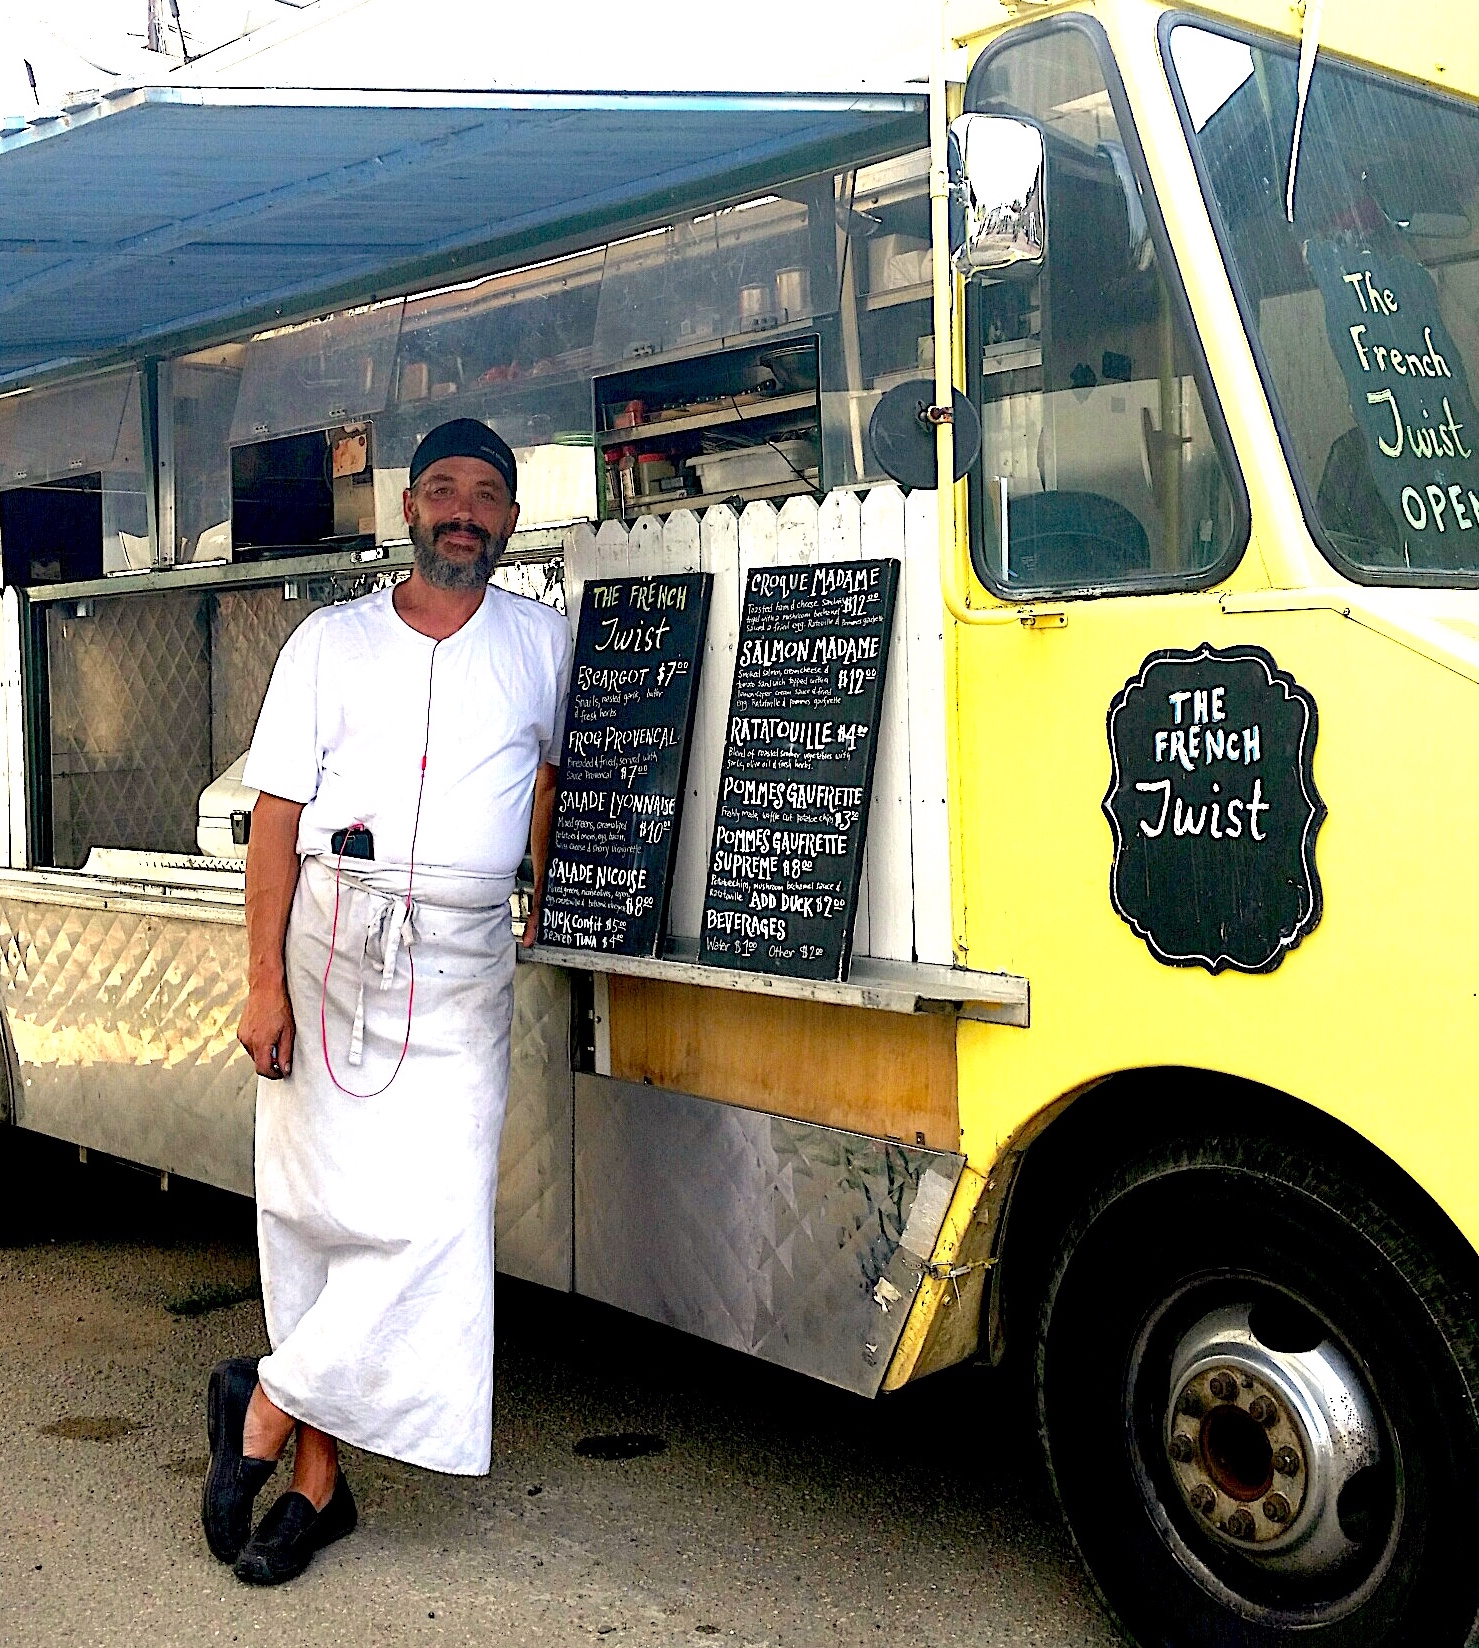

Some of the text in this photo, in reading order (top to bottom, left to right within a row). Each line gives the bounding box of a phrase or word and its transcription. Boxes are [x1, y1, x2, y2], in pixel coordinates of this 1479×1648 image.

[1343, 271, 1398, 316] The
[1350, 325, 1452, 377] French
[594, 583, 687, 611] THE FRENCH
[751, 568, 880, 599] CROQUE MADAME
[748, 604, 773, 614] Toasted
[740, 636, 879, 667] SALMON MADAME
[578, 666, 650, 692] ESCARGOT
[580, 709, 597, 722] fresh
[599, 708, 617, 717] herbs
[1168, 686, 1226, 725] THE
[569, 731, 602, 756] FROG
[730, 717, 833, 750] RATATOUILLE
[1155, 724, 1261, 771] FRENCH
[728, 746, 745, 757] Blend
[747, 748, 755, 759] of
[559, 791, 607, 812] SALADE
[723, 777, 863, 813] POMMES GAUFRETTE
[716, 825, 847, 857] POMMES GAUFRETTE
[548, 858, 647, 893] SALADE NICOISE
[713, 850, 778, 880] SUPREME
[749, 891, 776, 910] ADD
[779, 892, 814, 918] DUCK
[706, 909, 786, 940] BEVERAGES
[574, 932, 597, 948] TUNA
[706, 936, 731, 951] Water
[768, 945, 795, 959] Other
